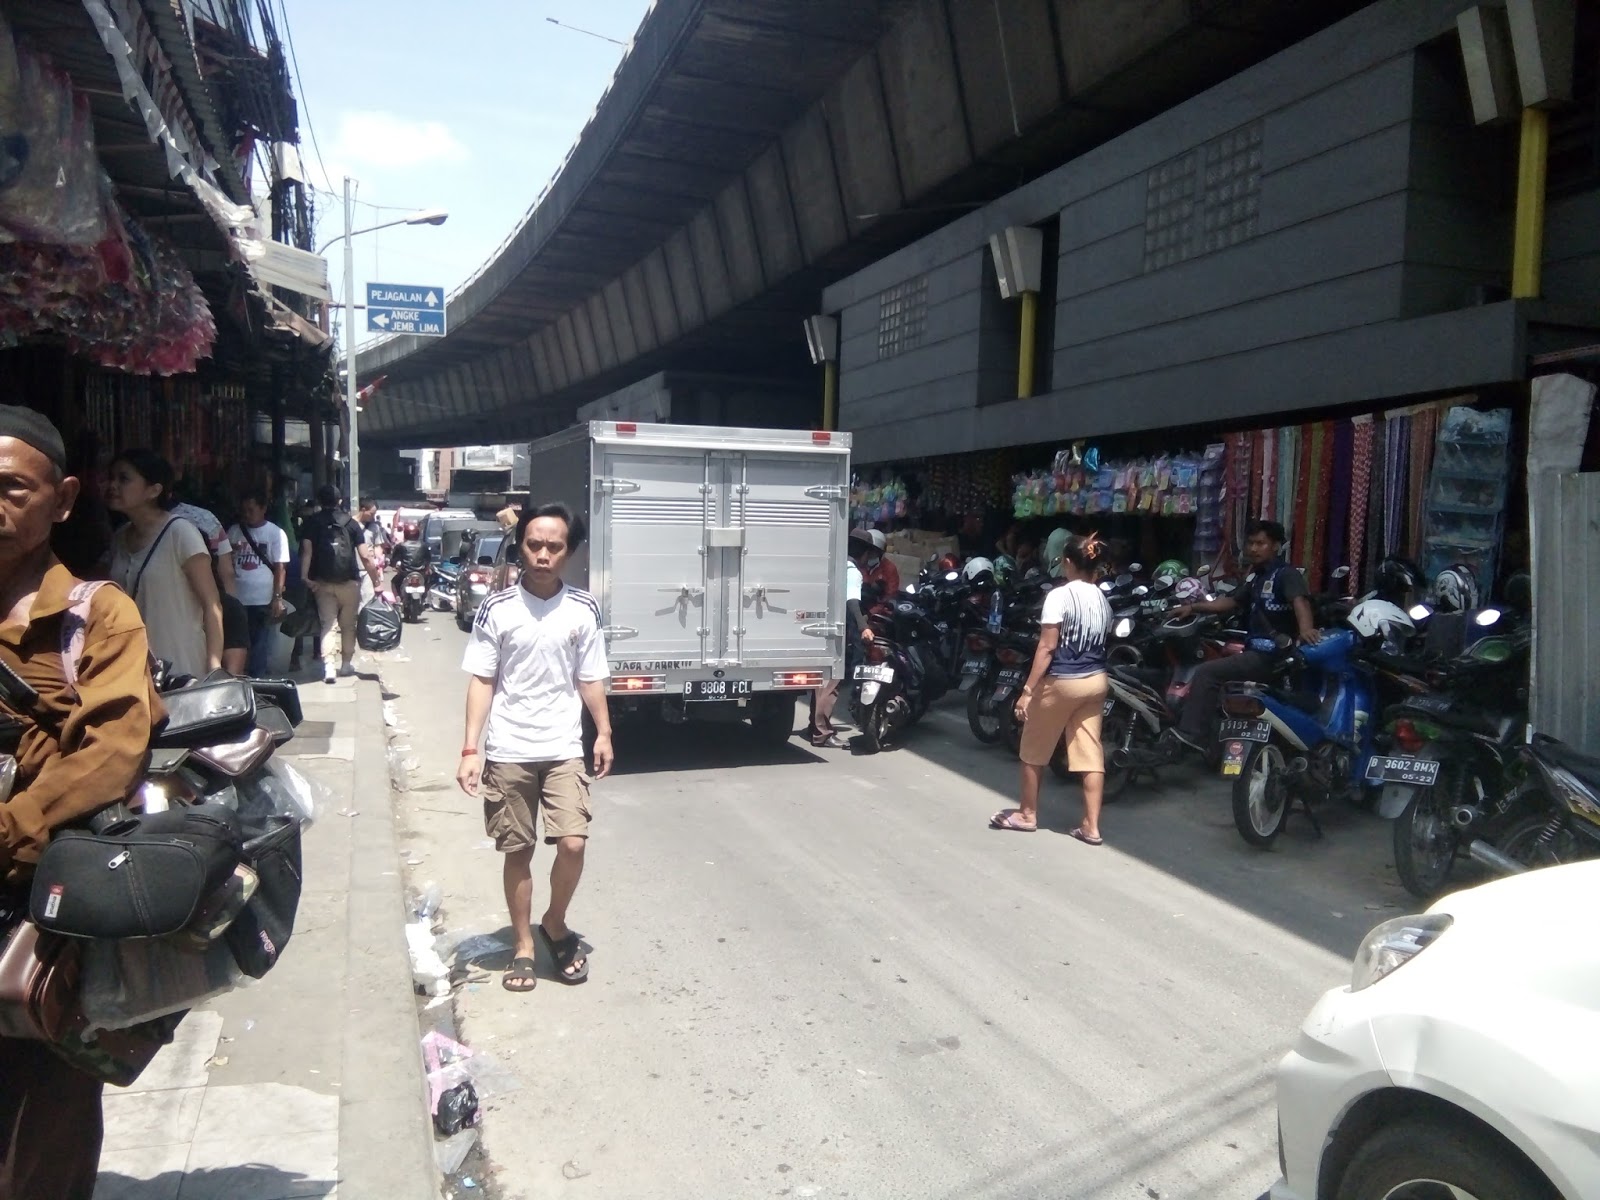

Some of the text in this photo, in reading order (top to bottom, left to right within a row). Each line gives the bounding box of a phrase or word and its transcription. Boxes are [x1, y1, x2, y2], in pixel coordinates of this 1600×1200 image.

[371, 290, 422, 303] PEJAGALAN
[390, 311, 420, 321] ANGKE
[391, 322, 416, 332] JEMB.
[419, 323, 440, 333] LIMA
[614, 661, 642, 671] JAGA
[685, 681, 692, 694] B
[700, 681, 726, 694] 9808
[1370, 758, 1437, 773] B 3602 BMX
